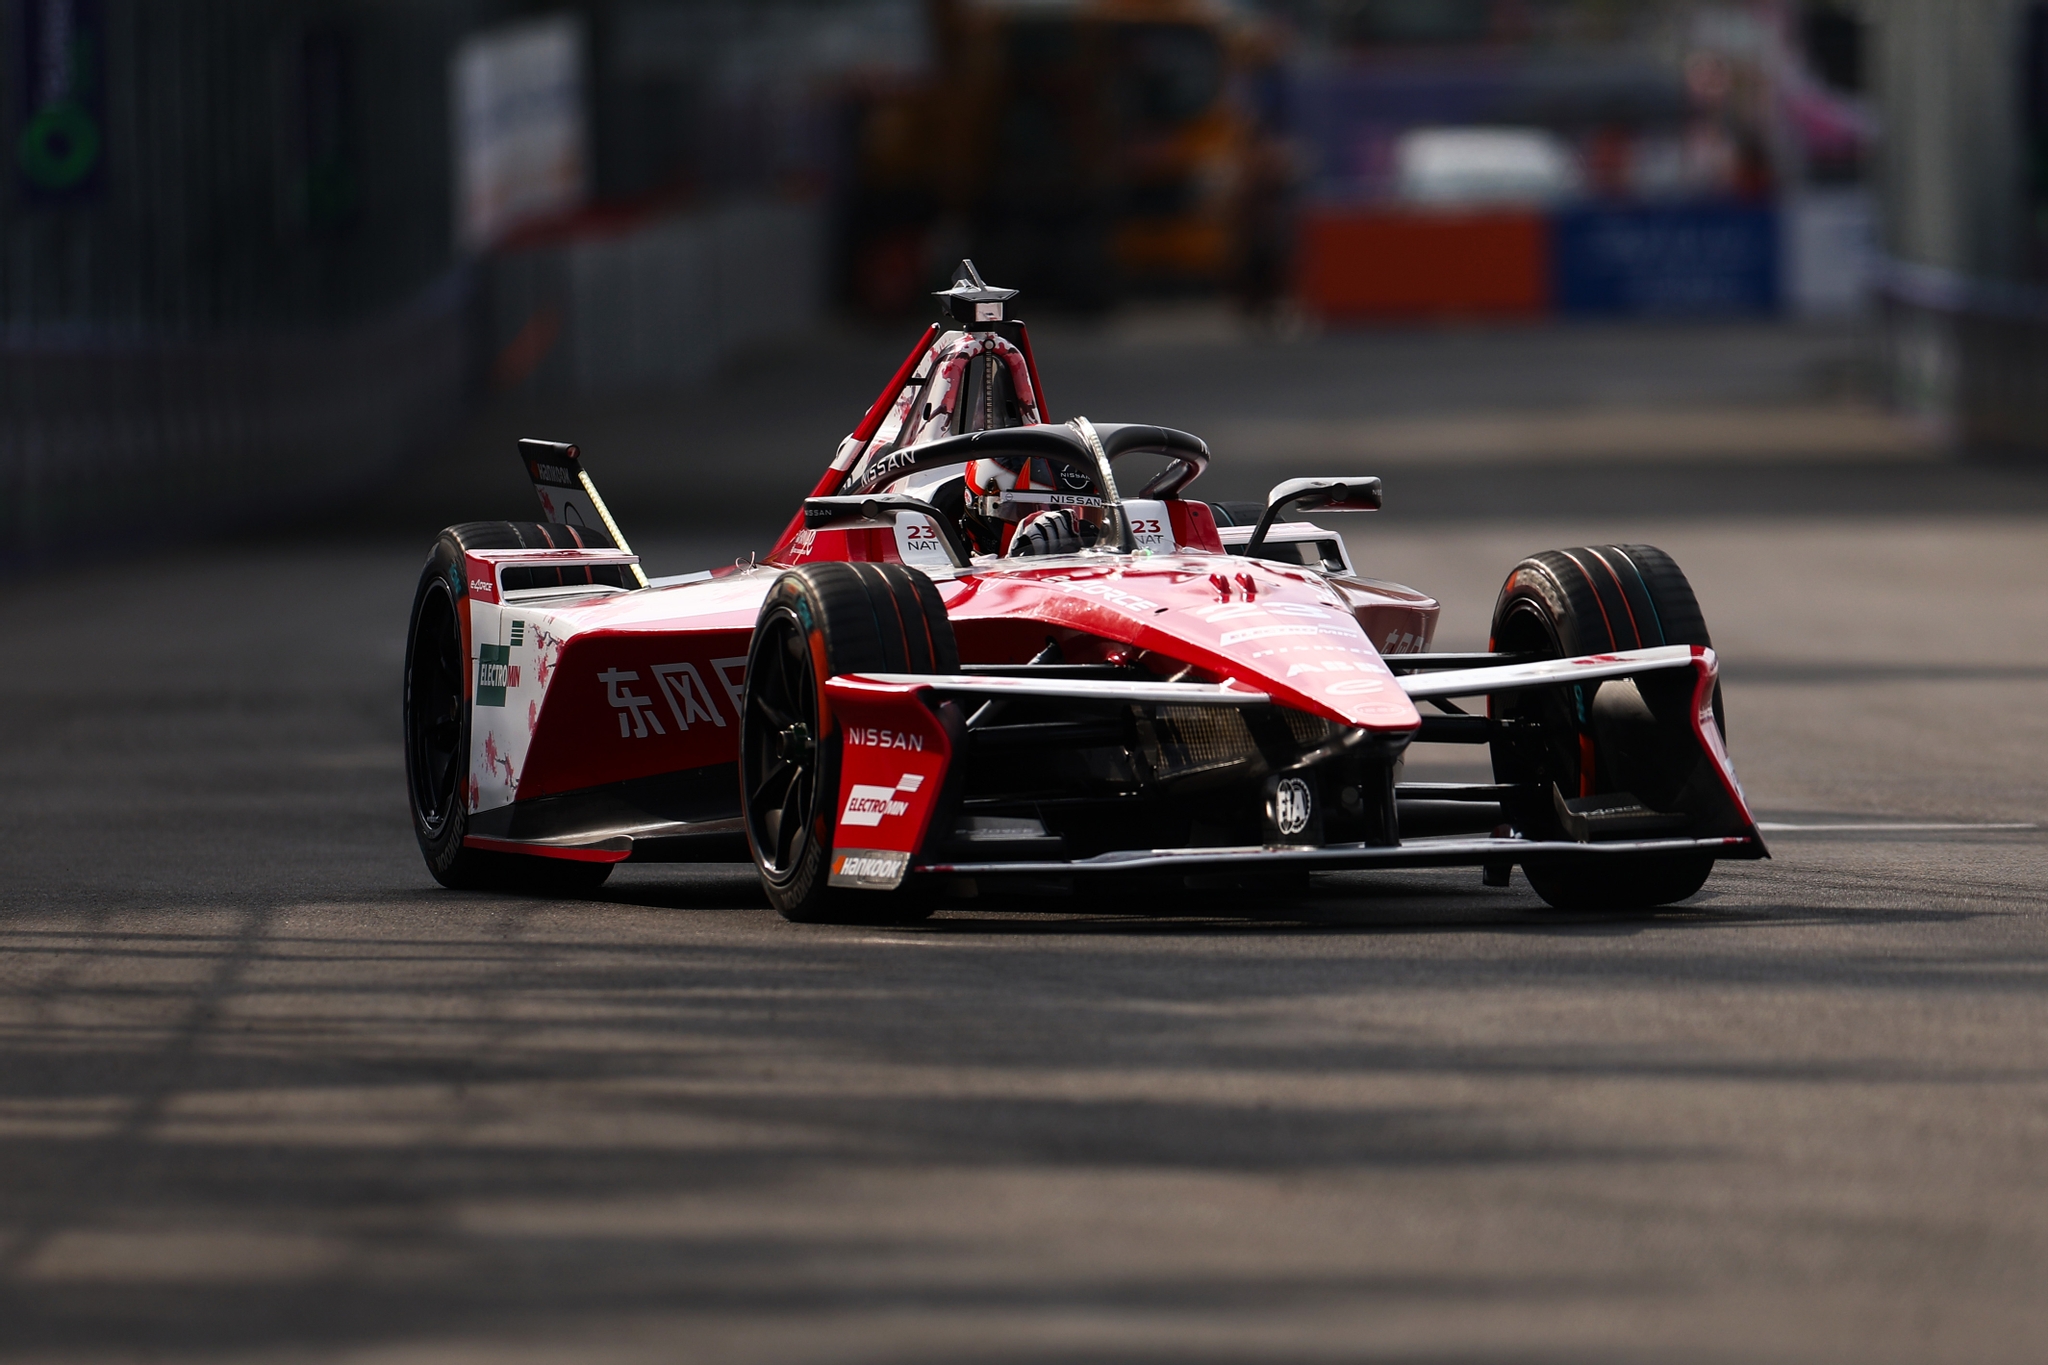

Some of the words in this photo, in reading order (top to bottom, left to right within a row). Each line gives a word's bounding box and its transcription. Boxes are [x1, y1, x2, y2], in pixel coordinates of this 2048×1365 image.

[861, 450, 917, 488] NISSAN
[1050, 495, 1101, 506] NISSAN
[906, 525, 936, 539] 23
[1131, 519, 1161, 533] 23
[907, 540, 938, 551] NAT
[1196, 602, 1332, 623] 23
[480, 663, 522, 688] ELECTROMIN
[849, 727, 923, 752] NISSAN
[848, 797, 909, 816] ELECTROMIN
